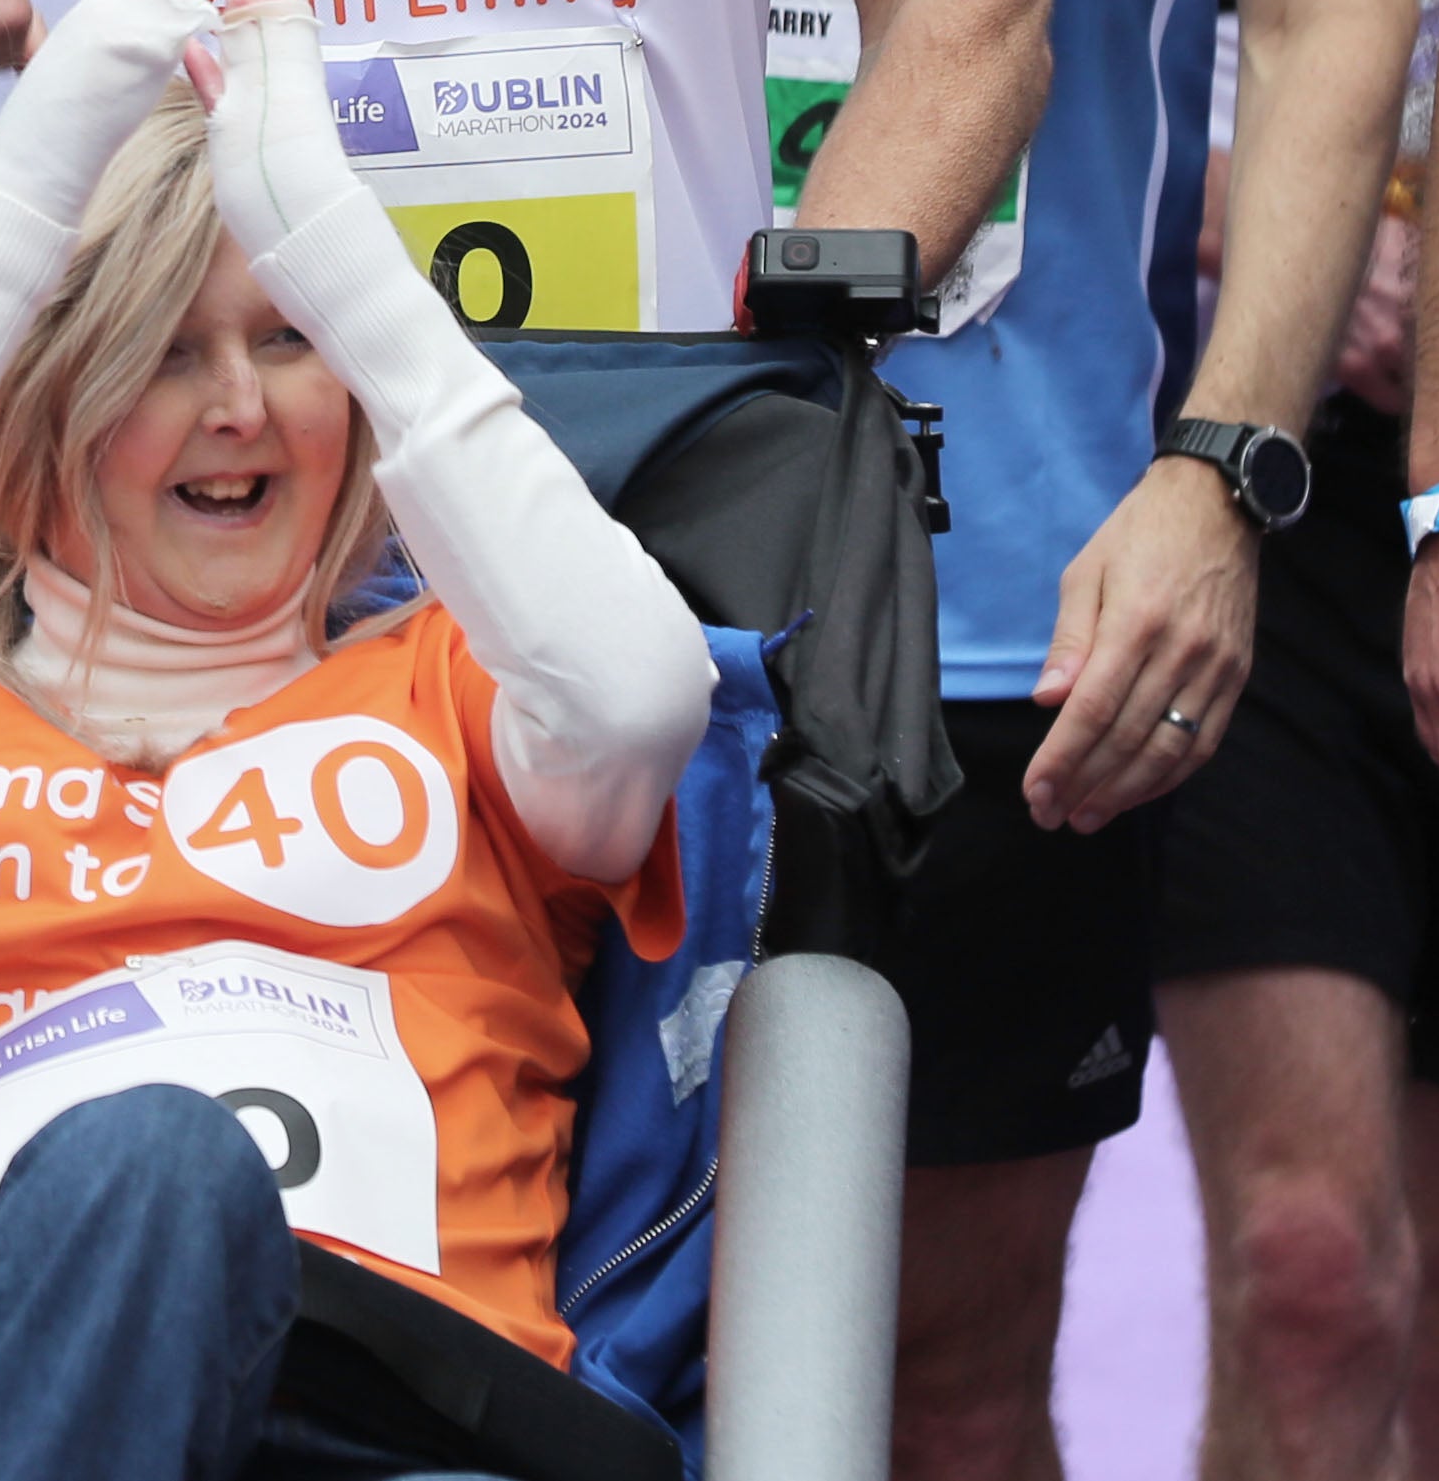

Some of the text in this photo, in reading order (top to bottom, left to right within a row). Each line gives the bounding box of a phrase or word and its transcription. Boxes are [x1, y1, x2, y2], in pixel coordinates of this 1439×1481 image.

[768, 7, 833, 38] ARRY
[331, 95, 386, 125] Life
[433, 73, 603, 116] DUBLIN
[437, 111, 608, 138] MARATHON 2024
[430, 220, 534, 330] 0
[185, 739, 431, 871] 40
[64, 842, 152, 903] to
[178, 975, 351, 1024] DUBLIN
[184, 999, 360, 1039] MARATHON 2024
[5, 1006, 128, 1061] Irish Life
